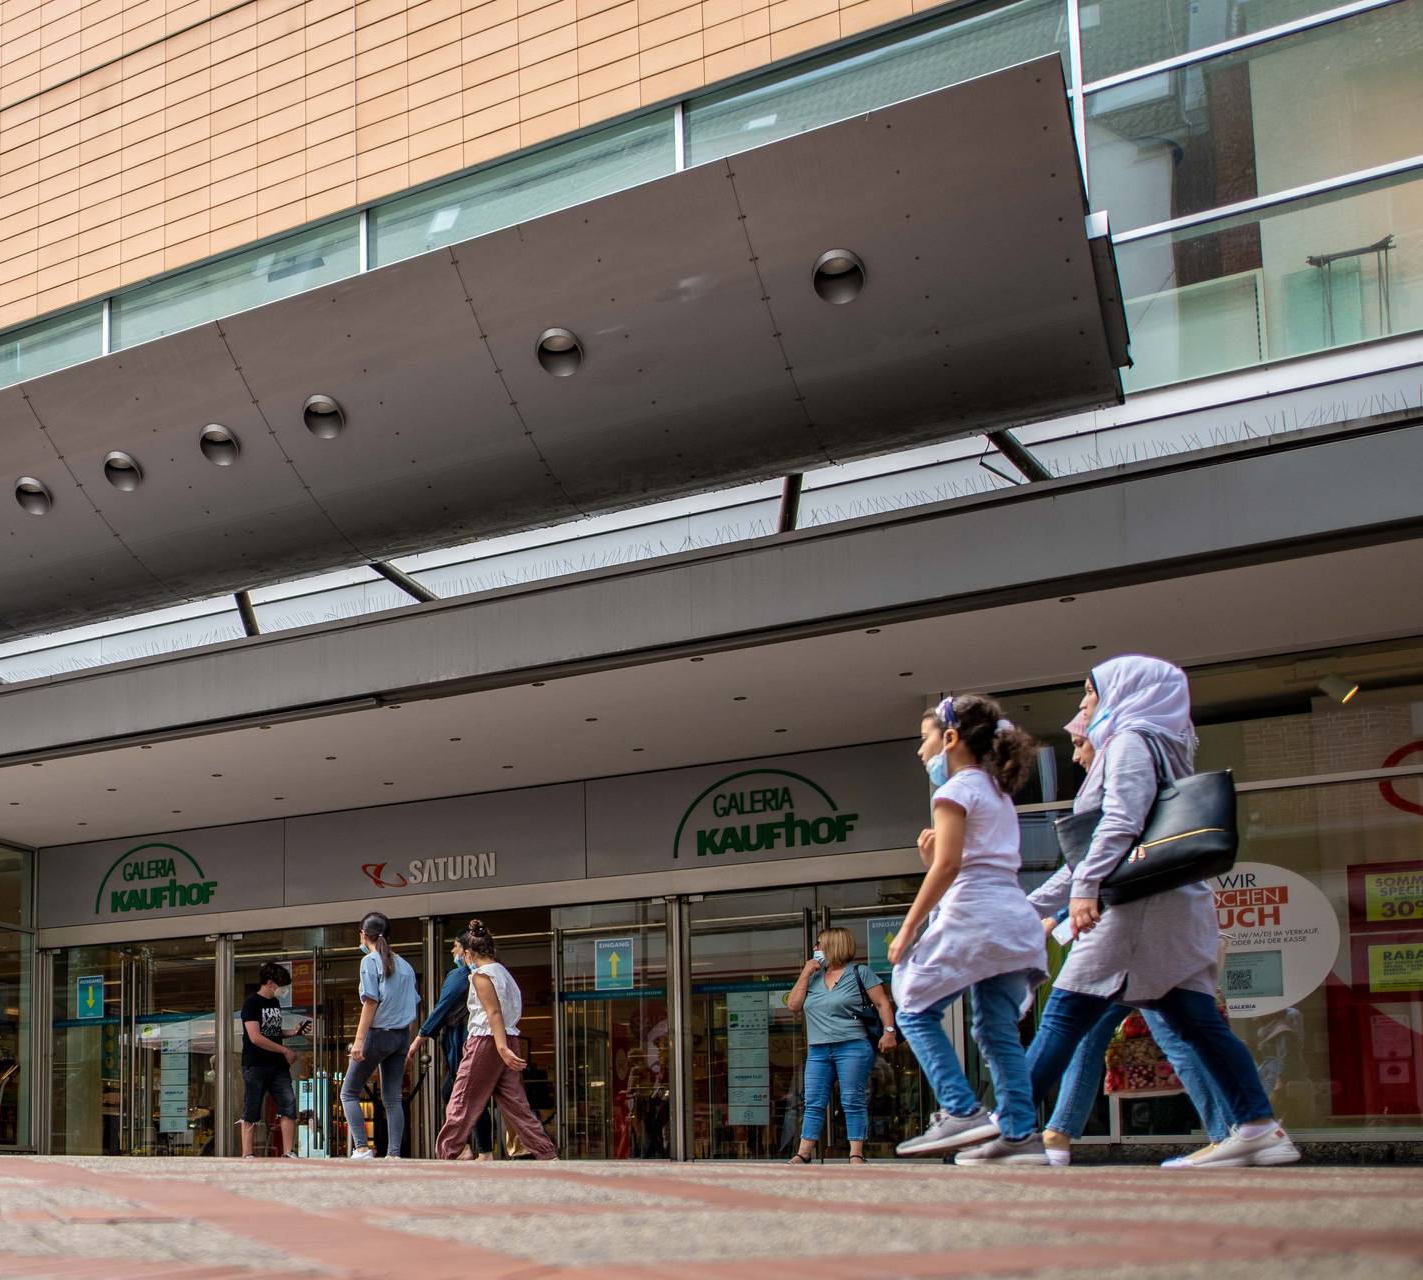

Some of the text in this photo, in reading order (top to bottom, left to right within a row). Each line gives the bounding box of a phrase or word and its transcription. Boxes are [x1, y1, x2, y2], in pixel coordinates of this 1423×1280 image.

[713, 786, 794, 817] GALERIA
[123, 858, 176, 882] GALERIA
[408, 852, 496, 884] SATURN
[1217, 873, 1257, 889] WIR
[1216, 888, 1280, 907] CHEN
[1380, 886, 1423, 896] SPECI
[872, 921, 901, 929] EINGAN
[1217, 906, 1280, 929] UCH
[599, 941, 629, 949] EINGANG
